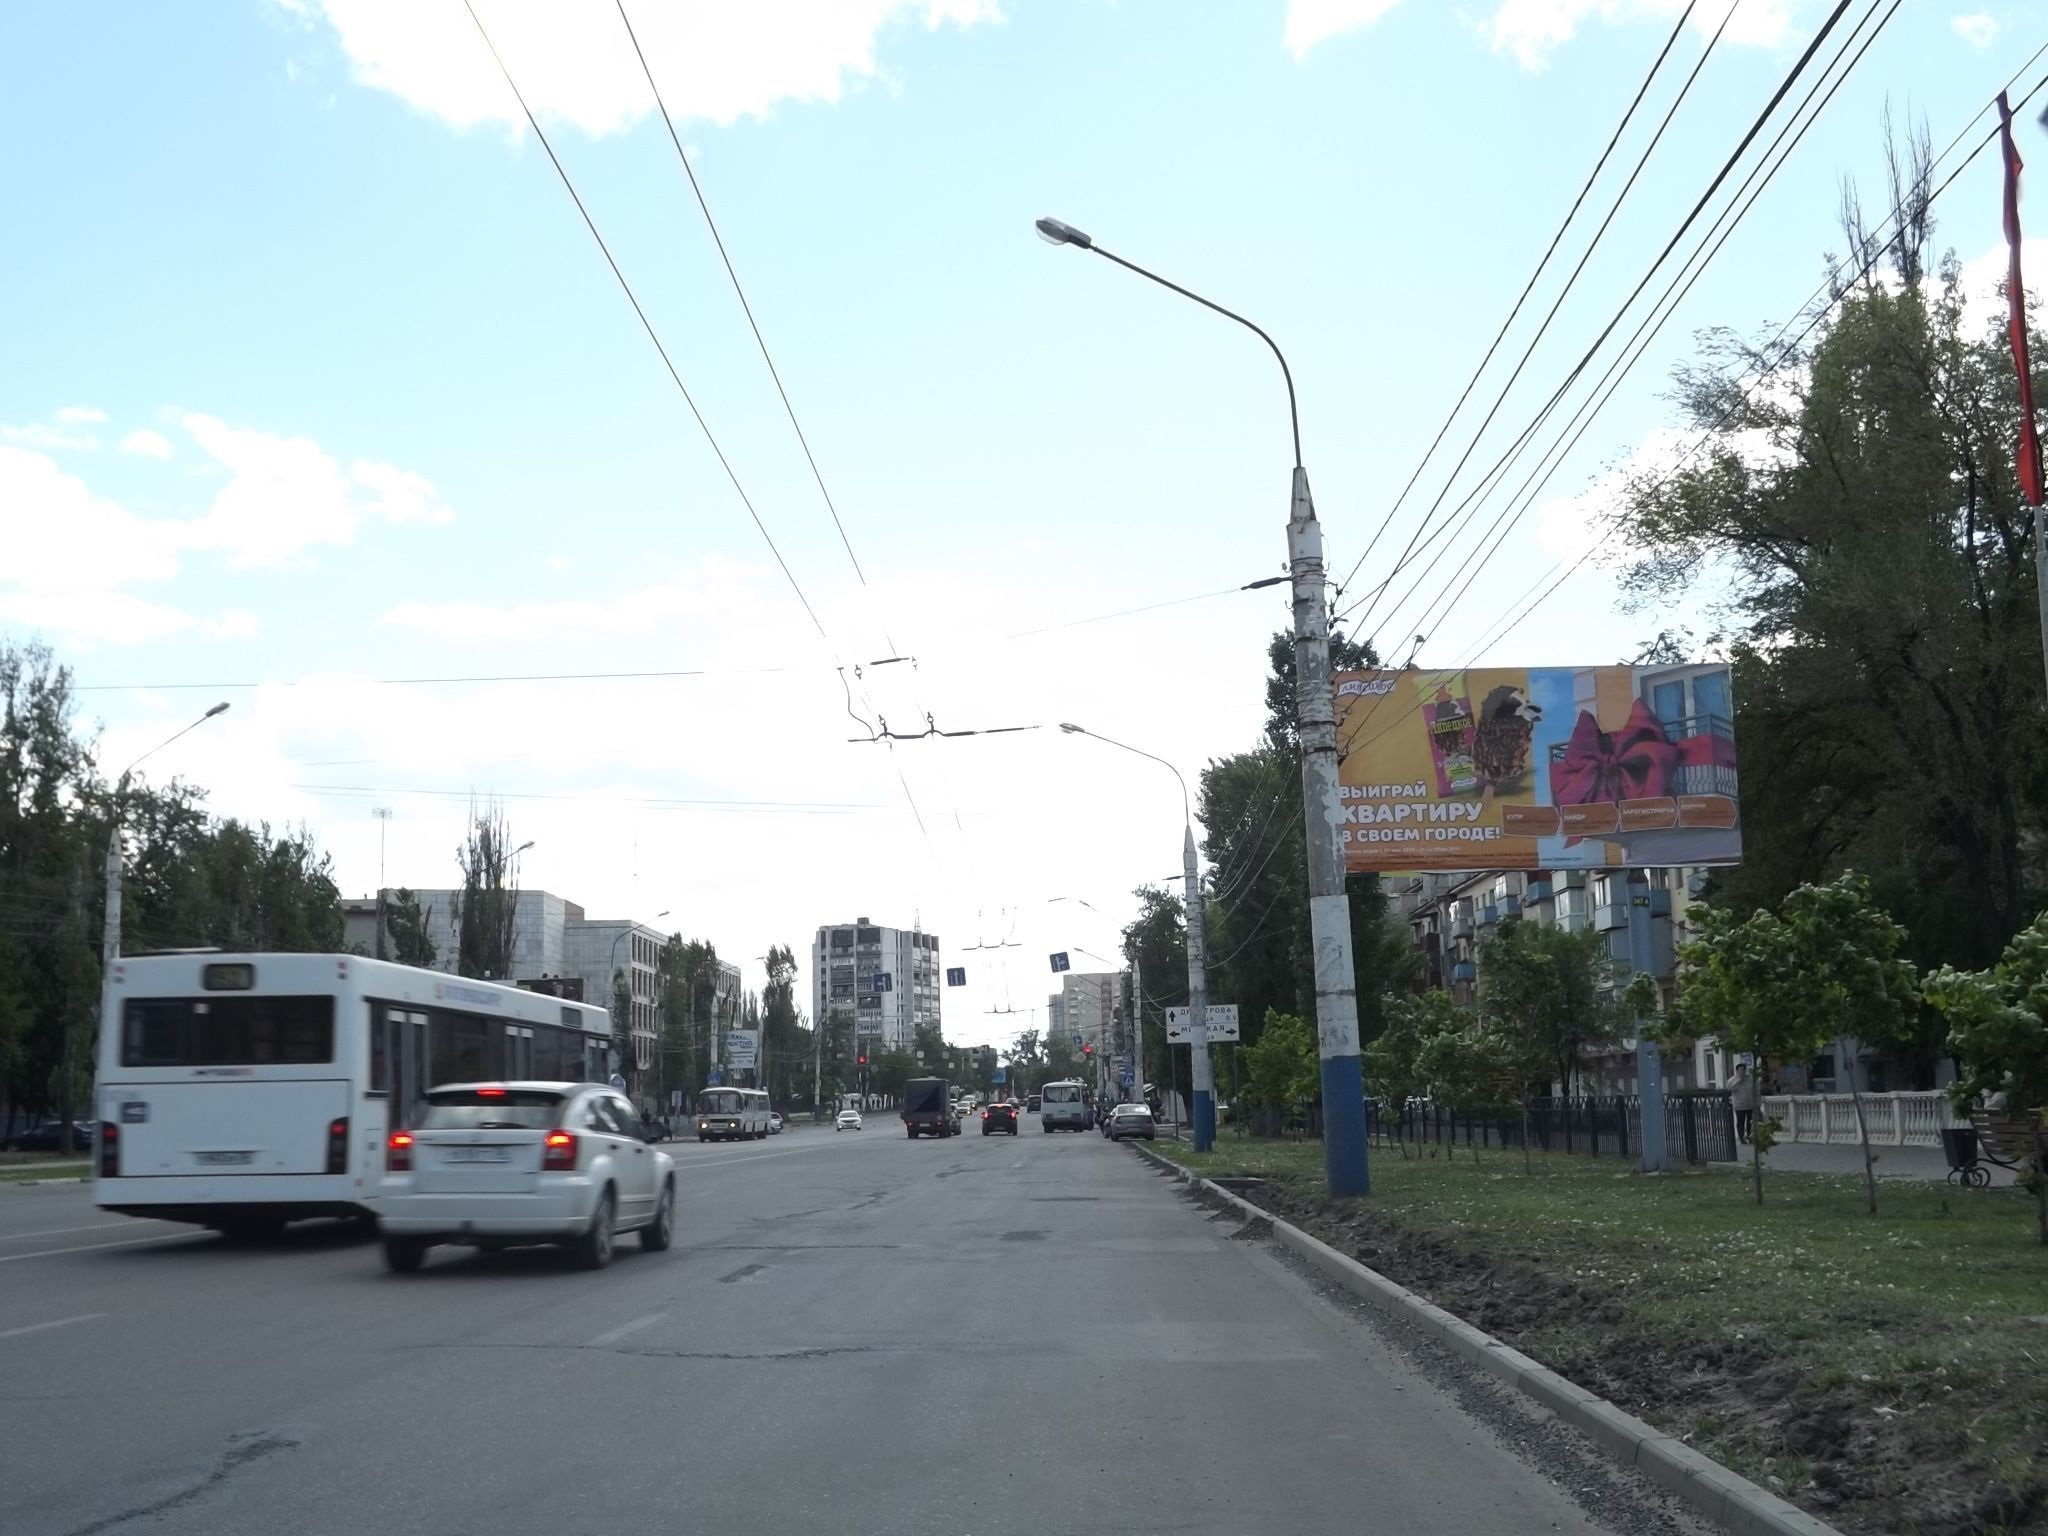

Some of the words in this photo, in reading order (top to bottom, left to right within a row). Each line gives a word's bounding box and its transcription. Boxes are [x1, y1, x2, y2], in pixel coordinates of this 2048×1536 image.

[1340, 780, 1428, 799] ВЫИГРАЙ
[1342, 802, 1483, 824] КВАРТИРУ
[1342, 829, 1353, 843] В
[1356, 828, 1420, 842] СВОЕМ
[1424, 826, 1501, 842] ГОРОДЕ!
